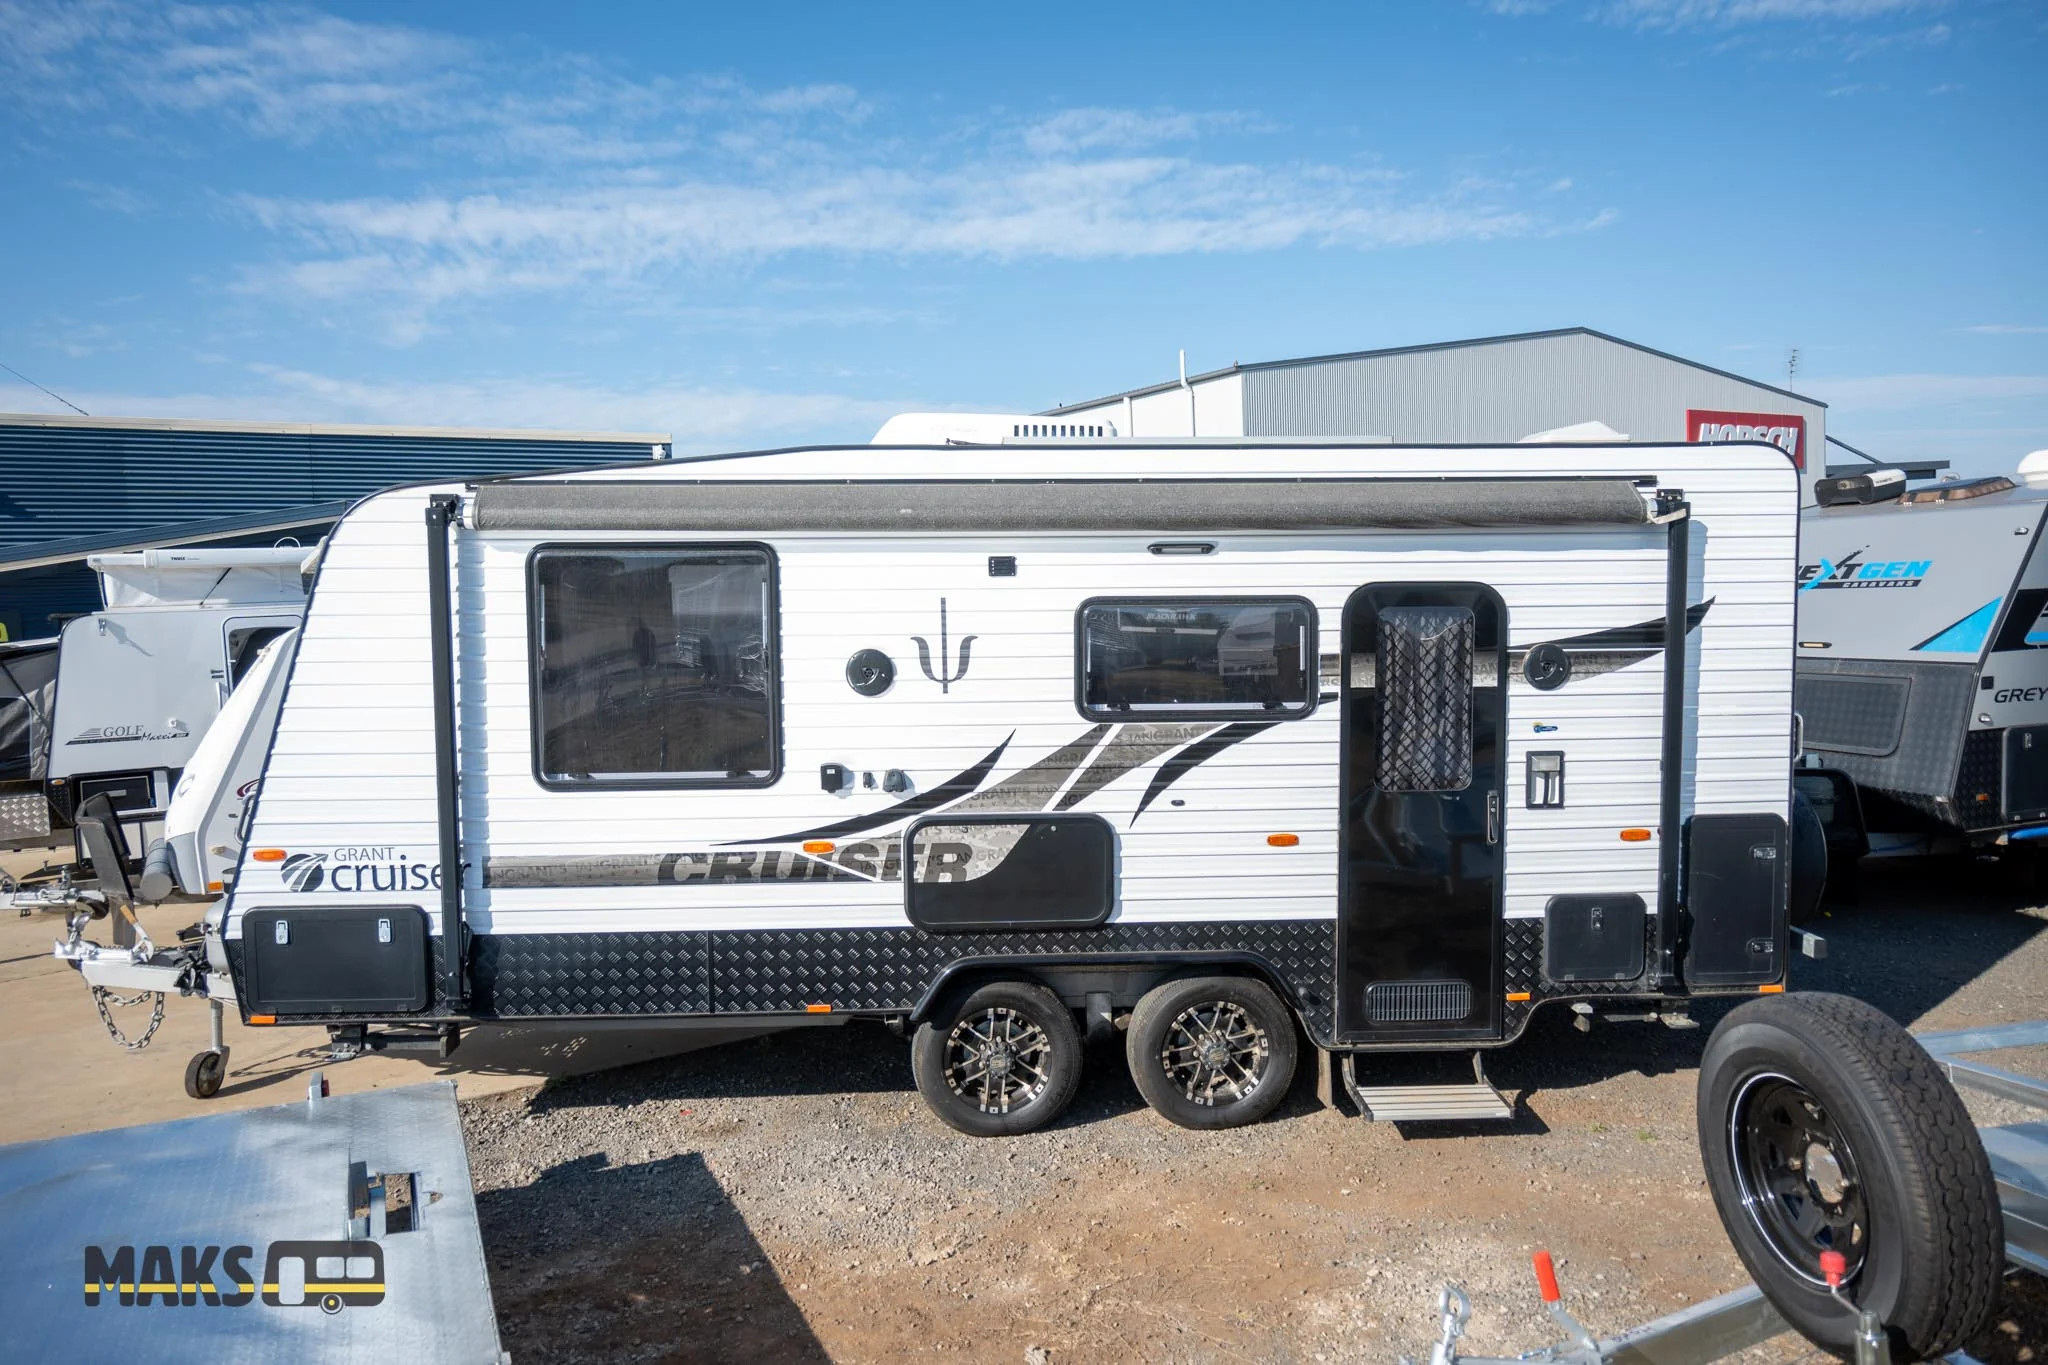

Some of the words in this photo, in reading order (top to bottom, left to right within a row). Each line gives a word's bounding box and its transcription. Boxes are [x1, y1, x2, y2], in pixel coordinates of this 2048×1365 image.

[1799, 556, 1933, 583] EXTGEN
[103, 725, 144, 738] GOLF
[334, 847, 395, 861] GRANT
[657, 843, 973, 884] CRUISER
